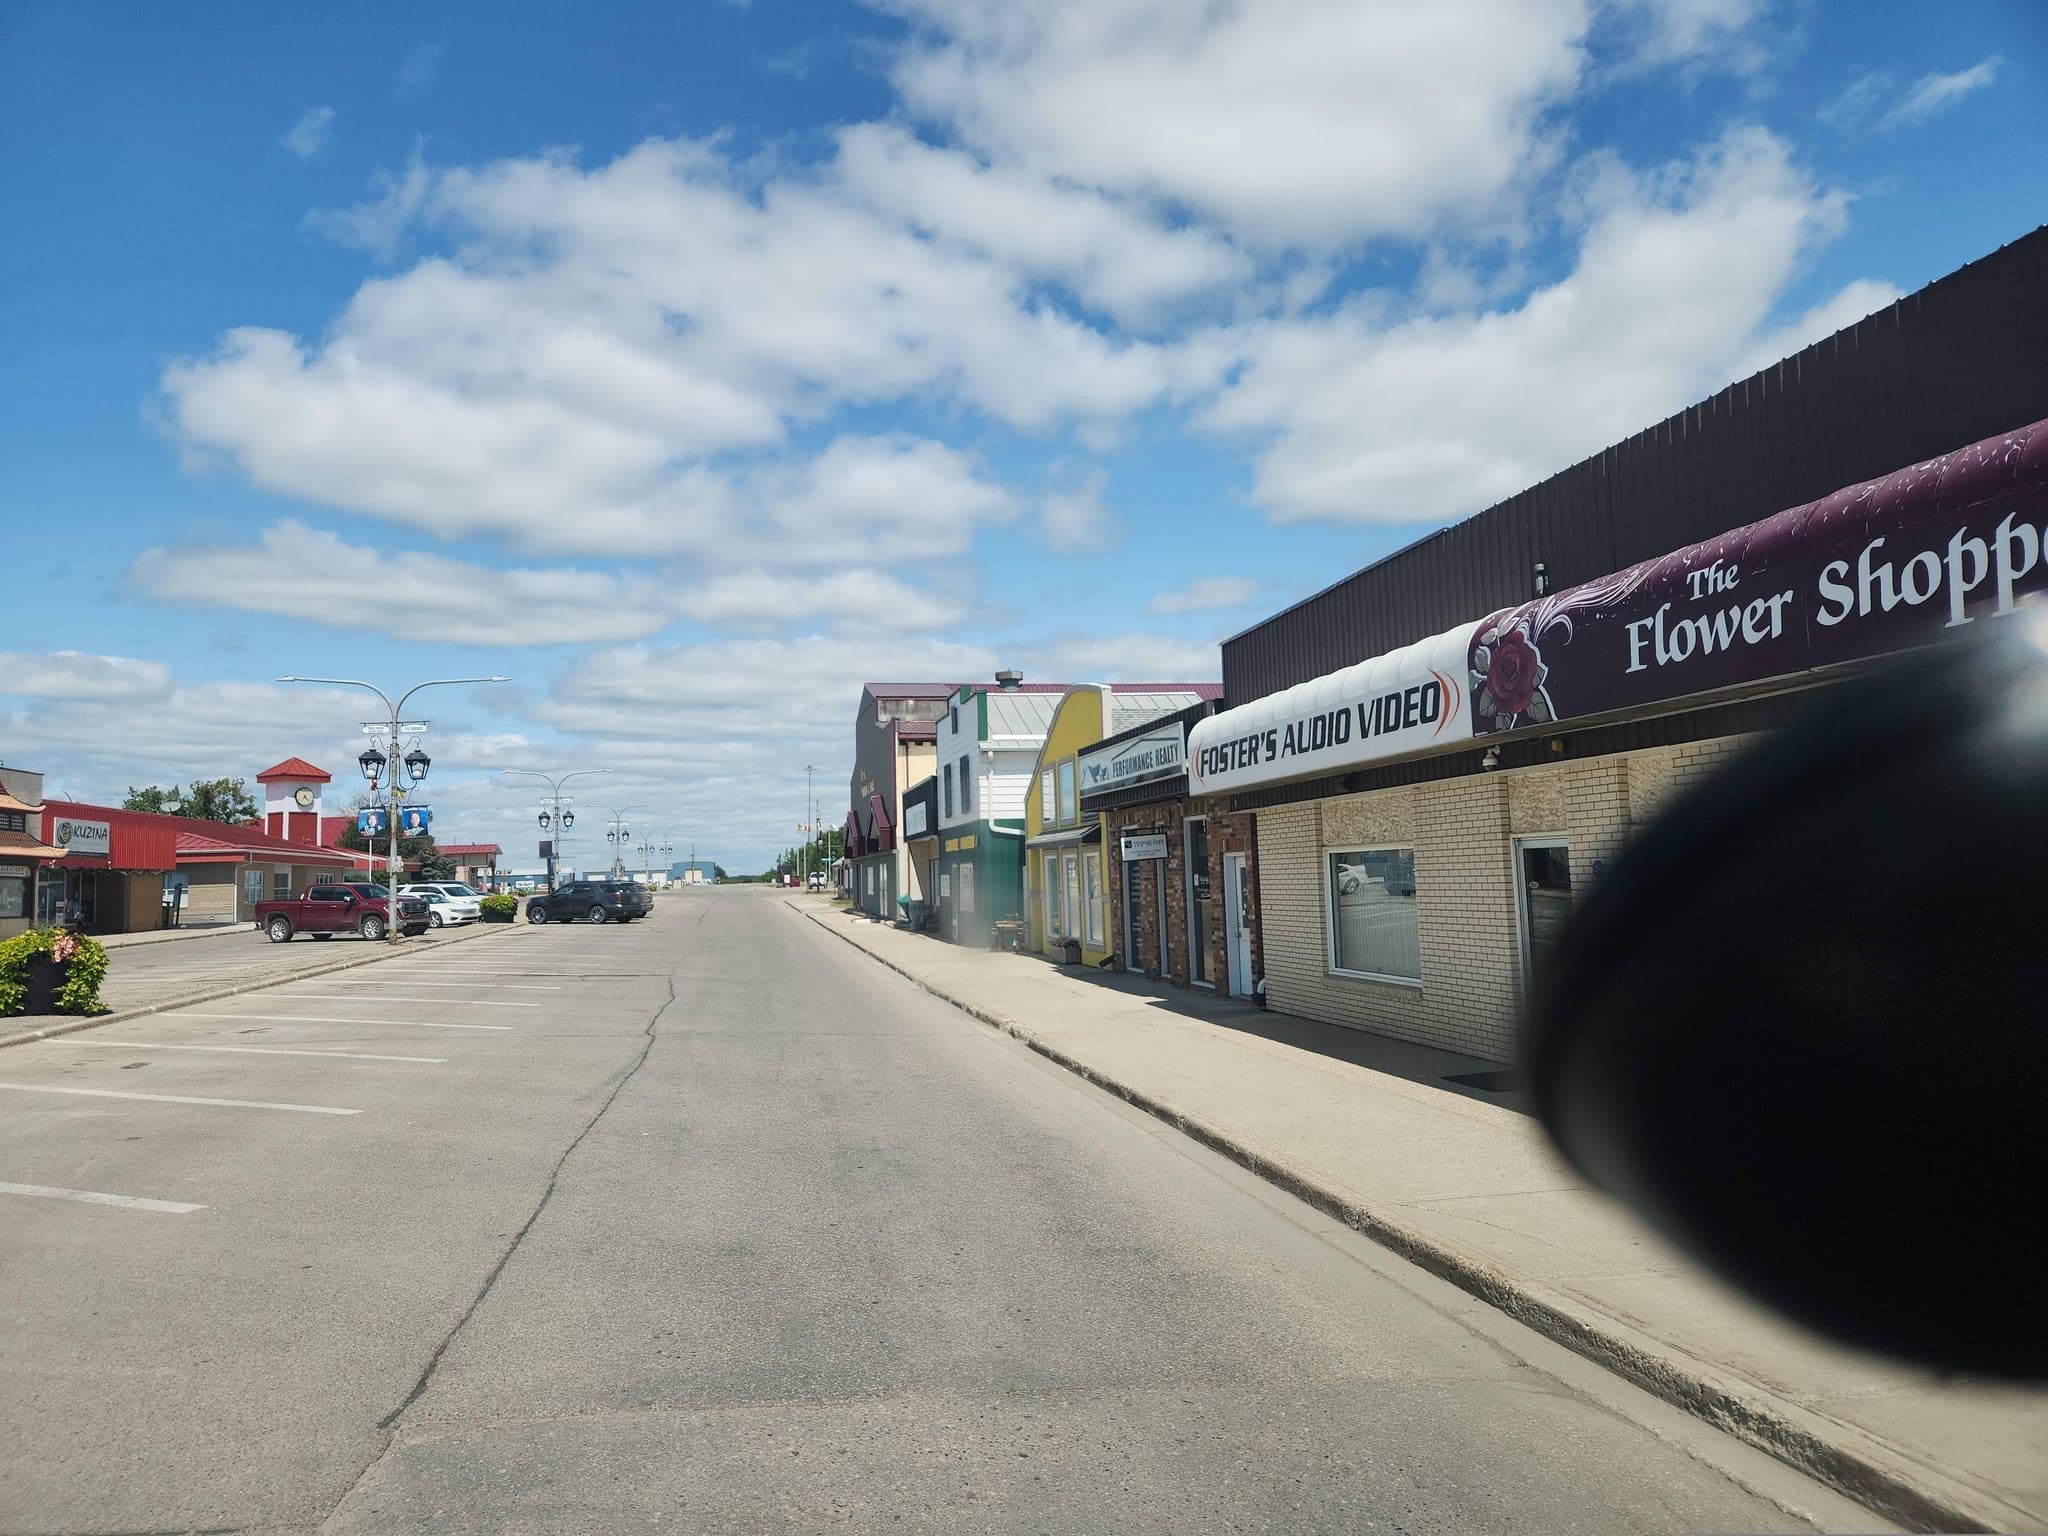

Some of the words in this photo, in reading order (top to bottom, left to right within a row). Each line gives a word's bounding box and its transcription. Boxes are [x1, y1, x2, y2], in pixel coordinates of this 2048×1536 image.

[1625, 590, 1794, 674] Flower
[1815, 511, 2048, 628] Shopp
[1686, 559, 1740, 601] The
[1200, 728, 1277, 778] FOSTER'S
[1281, 707, 1351, 759] AUDIO
[1357, 680, 1441, 739] VIDEO
[1112, 751, 1153, 779] PERFORMANCE
[1155, 743, 1179, 766] REALTY
[73, 825, 108, 840] KUZINA
